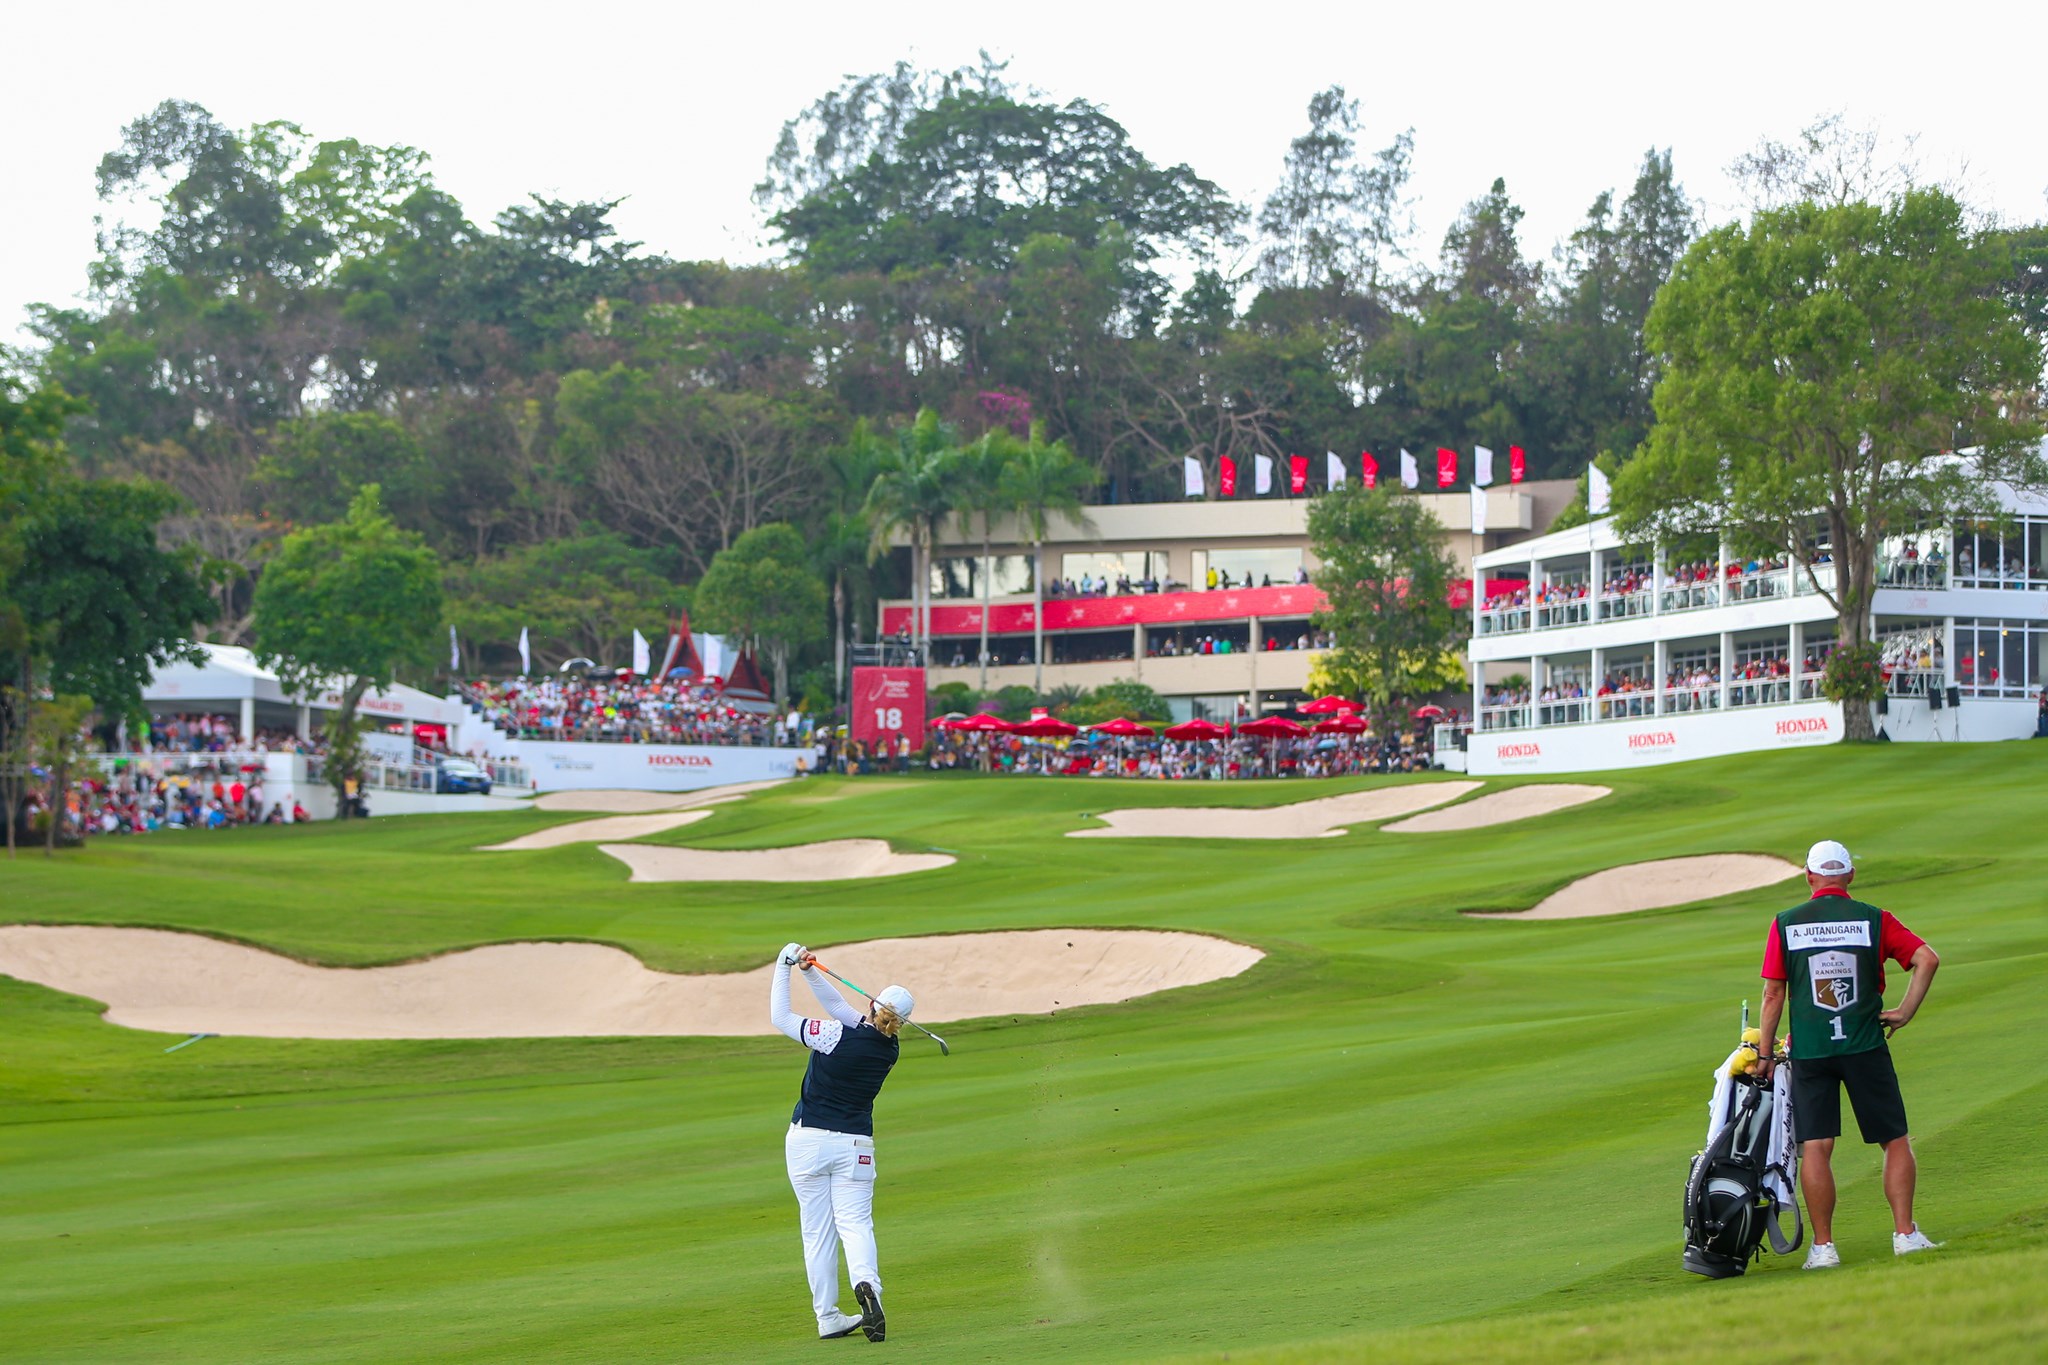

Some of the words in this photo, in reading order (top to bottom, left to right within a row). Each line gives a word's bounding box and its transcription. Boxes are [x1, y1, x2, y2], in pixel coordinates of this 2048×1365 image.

[875, 707, 902, 730] 18
[1776, 717, 1828, 735] HONDA
[1628, 731, 1676, 748] HONDA
[1497, 742, 1541, 758] HONDA
[648, 754, 712, 768] HONDA
[1793, 929, 1802, 938] A.
[1803, 925, 1863, 937] JUTANUGARN
[1829, 1016, 1847, 1040] 1
